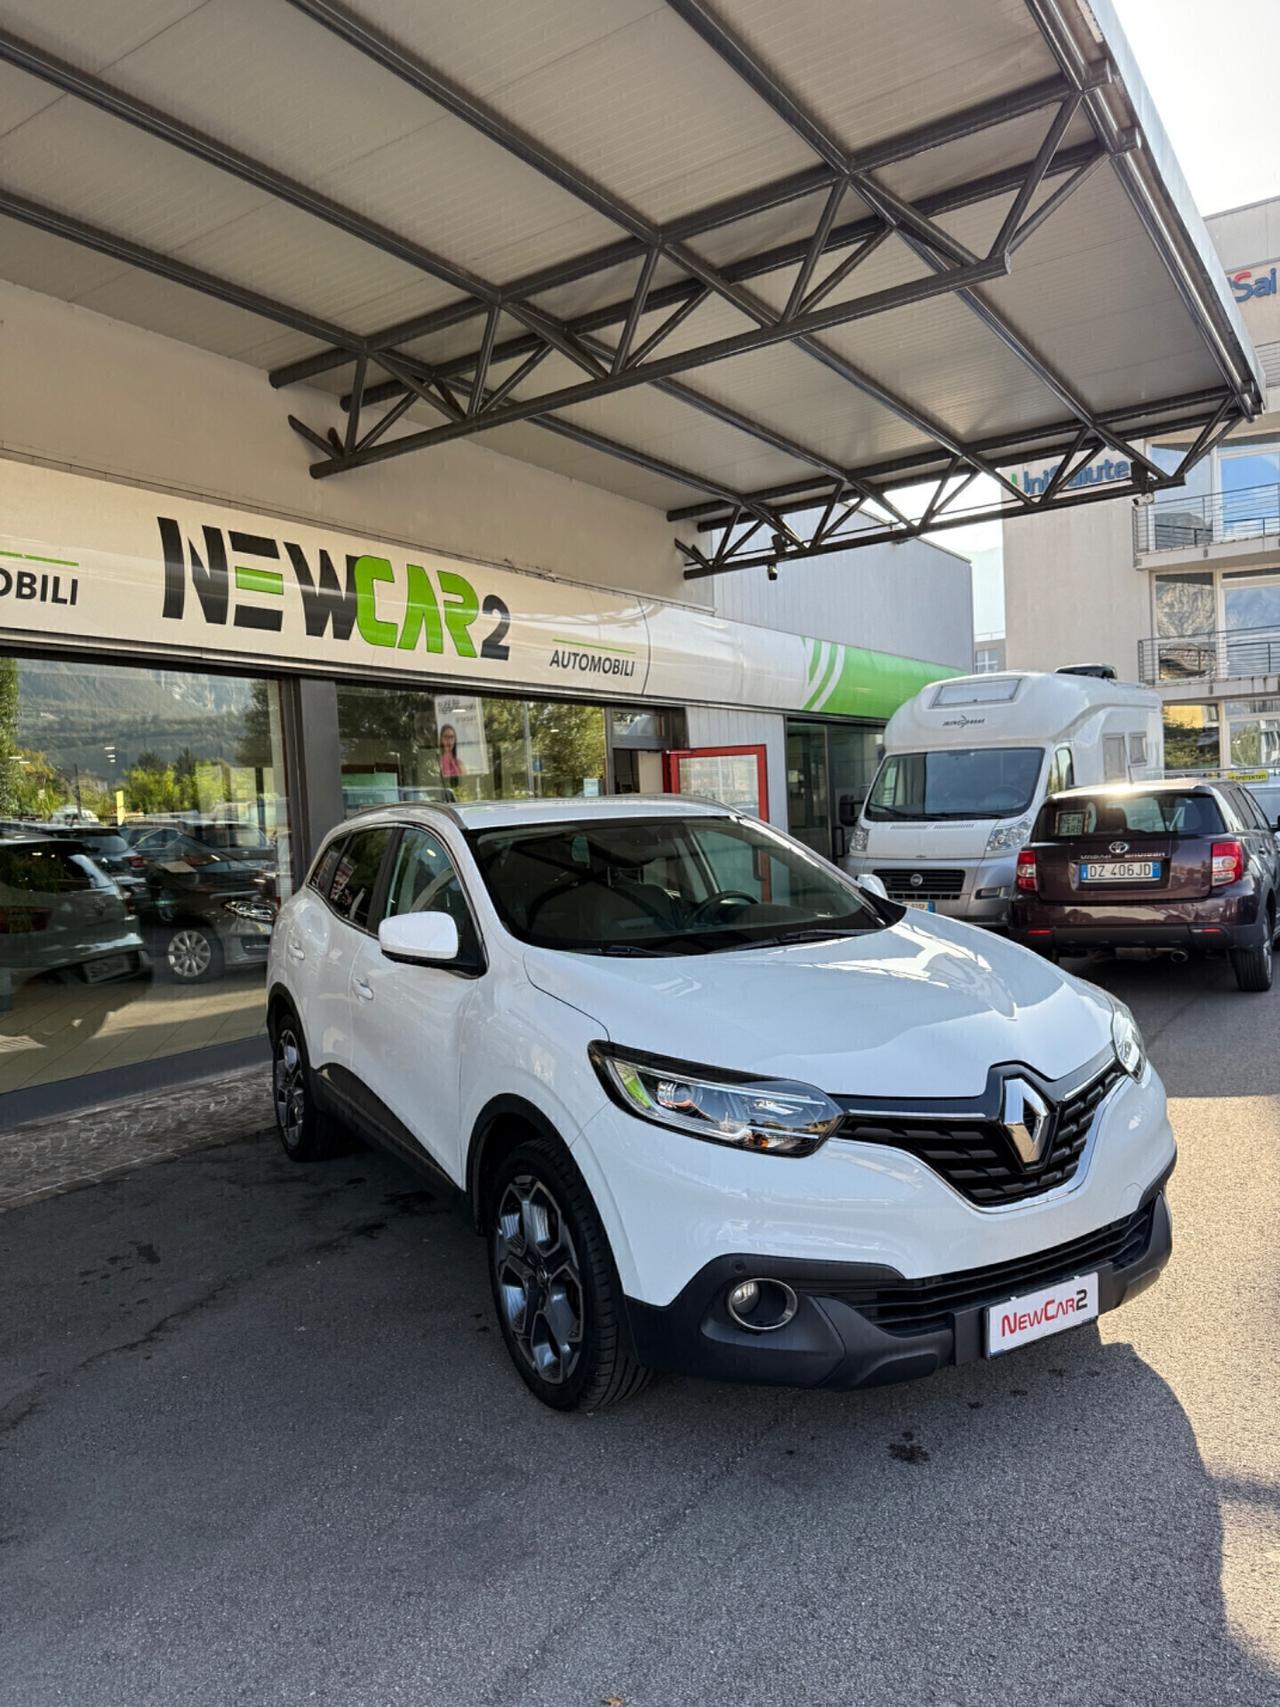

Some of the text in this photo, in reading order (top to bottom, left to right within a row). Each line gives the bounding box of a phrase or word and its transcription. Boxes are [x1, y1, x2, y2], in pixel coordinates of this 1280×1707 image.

[1227, 268, 1277, 303] Sai
[550, 649, 635, 678] AUTOMOBILI
[1089, 863, 1152, 877] DZ 406JD
